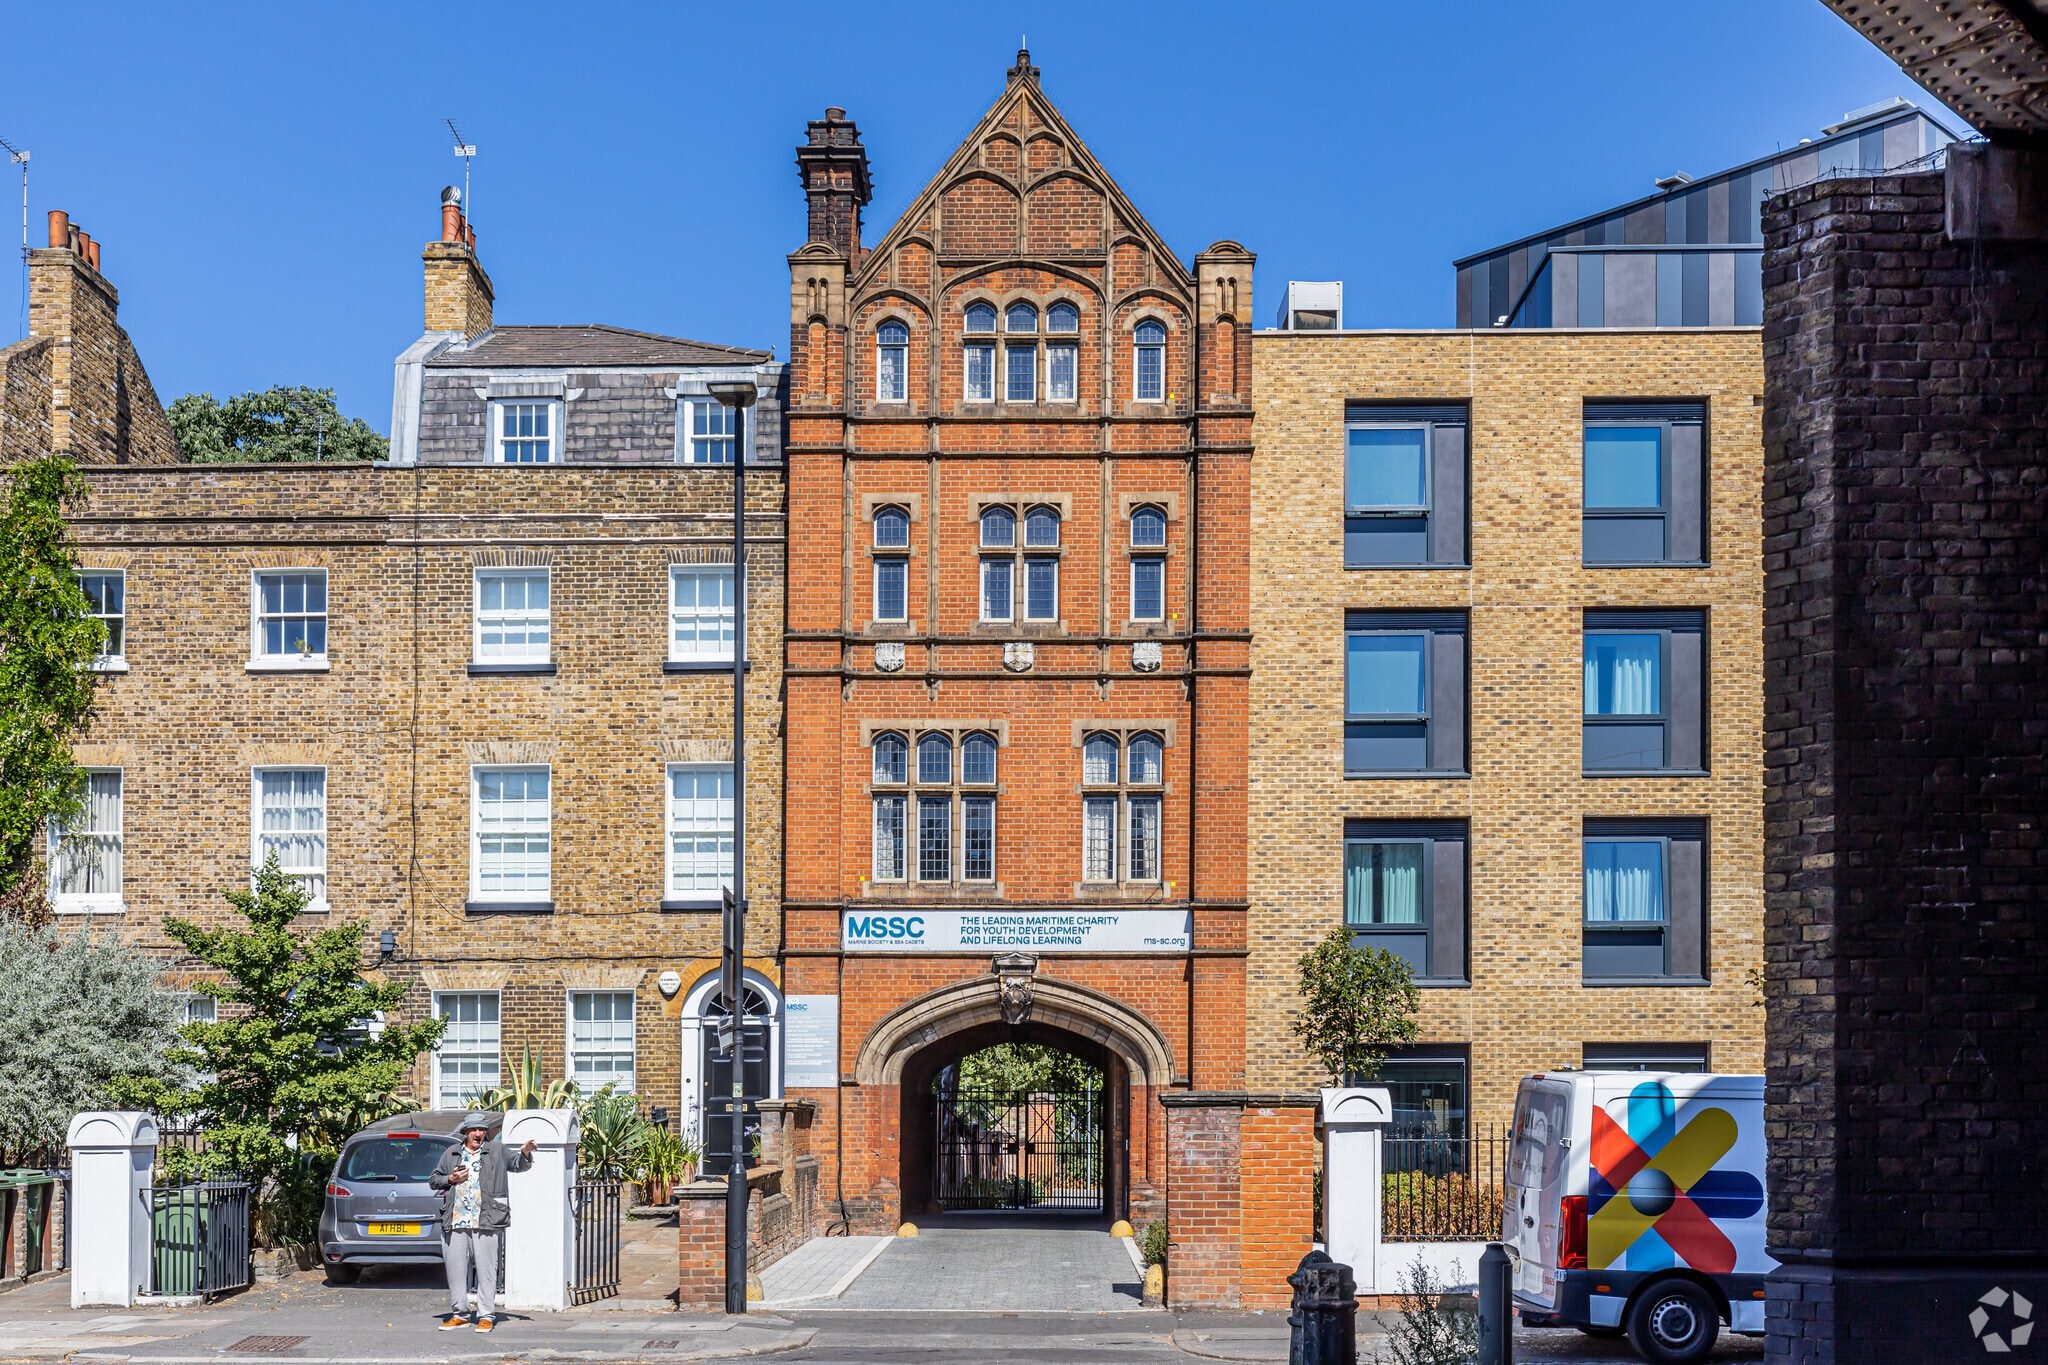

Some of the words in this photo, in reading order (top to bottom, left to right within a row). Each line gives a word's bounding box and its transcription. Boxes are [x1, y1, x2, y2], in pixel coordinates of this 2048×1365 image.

[960, 916, 980, 925] THE
[982, 916, 1024, 925] LEADING
[1026, 916, 1075, 925] MARITIME
[1076, 916, 1119, 925] CHARITY
[848, 916, 925, 938] MSSC
[960, 926, 981, 935] FOR
[982, 926, 1016, 935] YOUTH
[1018, 926, 1092, 935] DEVELOPMENT
[960, 936, 981, 945] AND
[983, 936, 1030, 945] LIFELONG
[1032, 936, 1082, 945] LEARNING
[1144, 938, 1186, 946] ms-sc.org
[380, 1224, 388, 1232] A1
[390, 1224, 408, 1232] HBL
